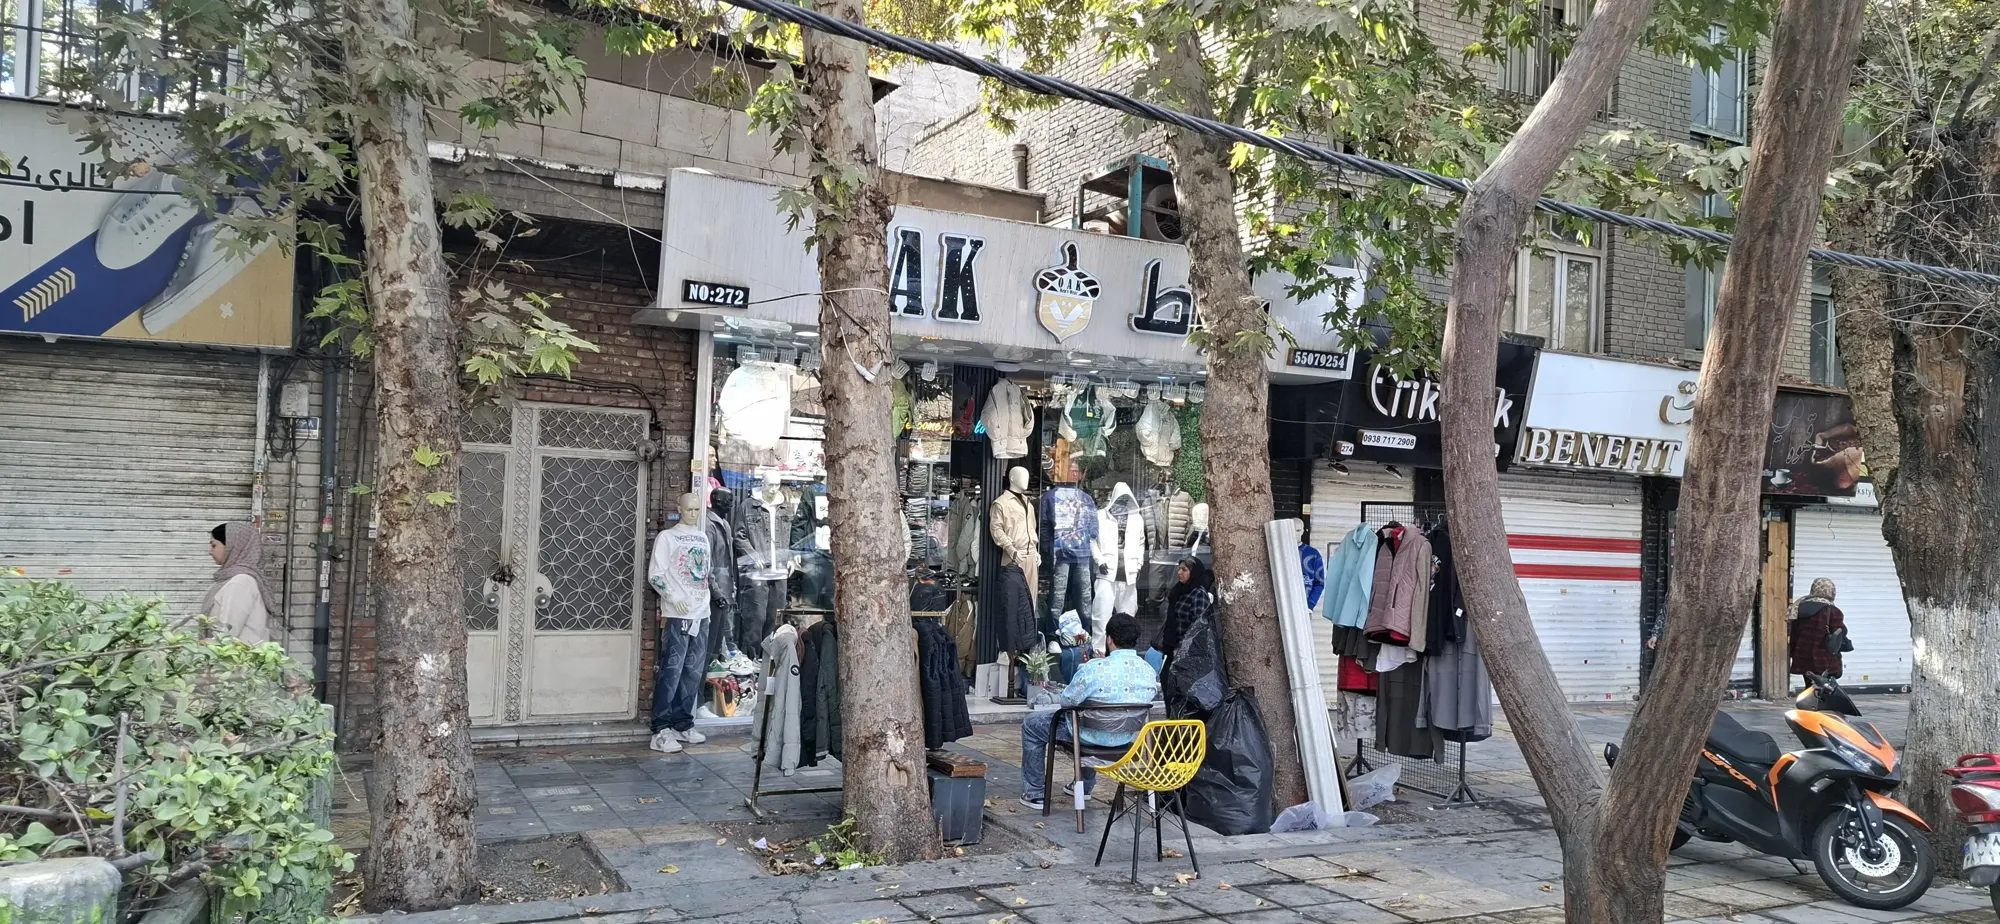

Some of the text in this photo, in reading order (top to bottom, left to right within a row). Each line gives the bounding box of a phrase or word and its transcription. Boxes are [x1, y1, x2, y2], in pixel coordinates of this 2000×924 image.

[889, 226, 985, 324] AK
[1058, 277, 1082, 291] OAK
[689, 283, 744, 305] NO:272
[1294, 351, 1345, 369] 55079254
[1341, 445, 1353, 453] 274
[1363, 434, 1415, 447] 0938 717 2908
[1525, 427, 1683, 474] BENEFIT
